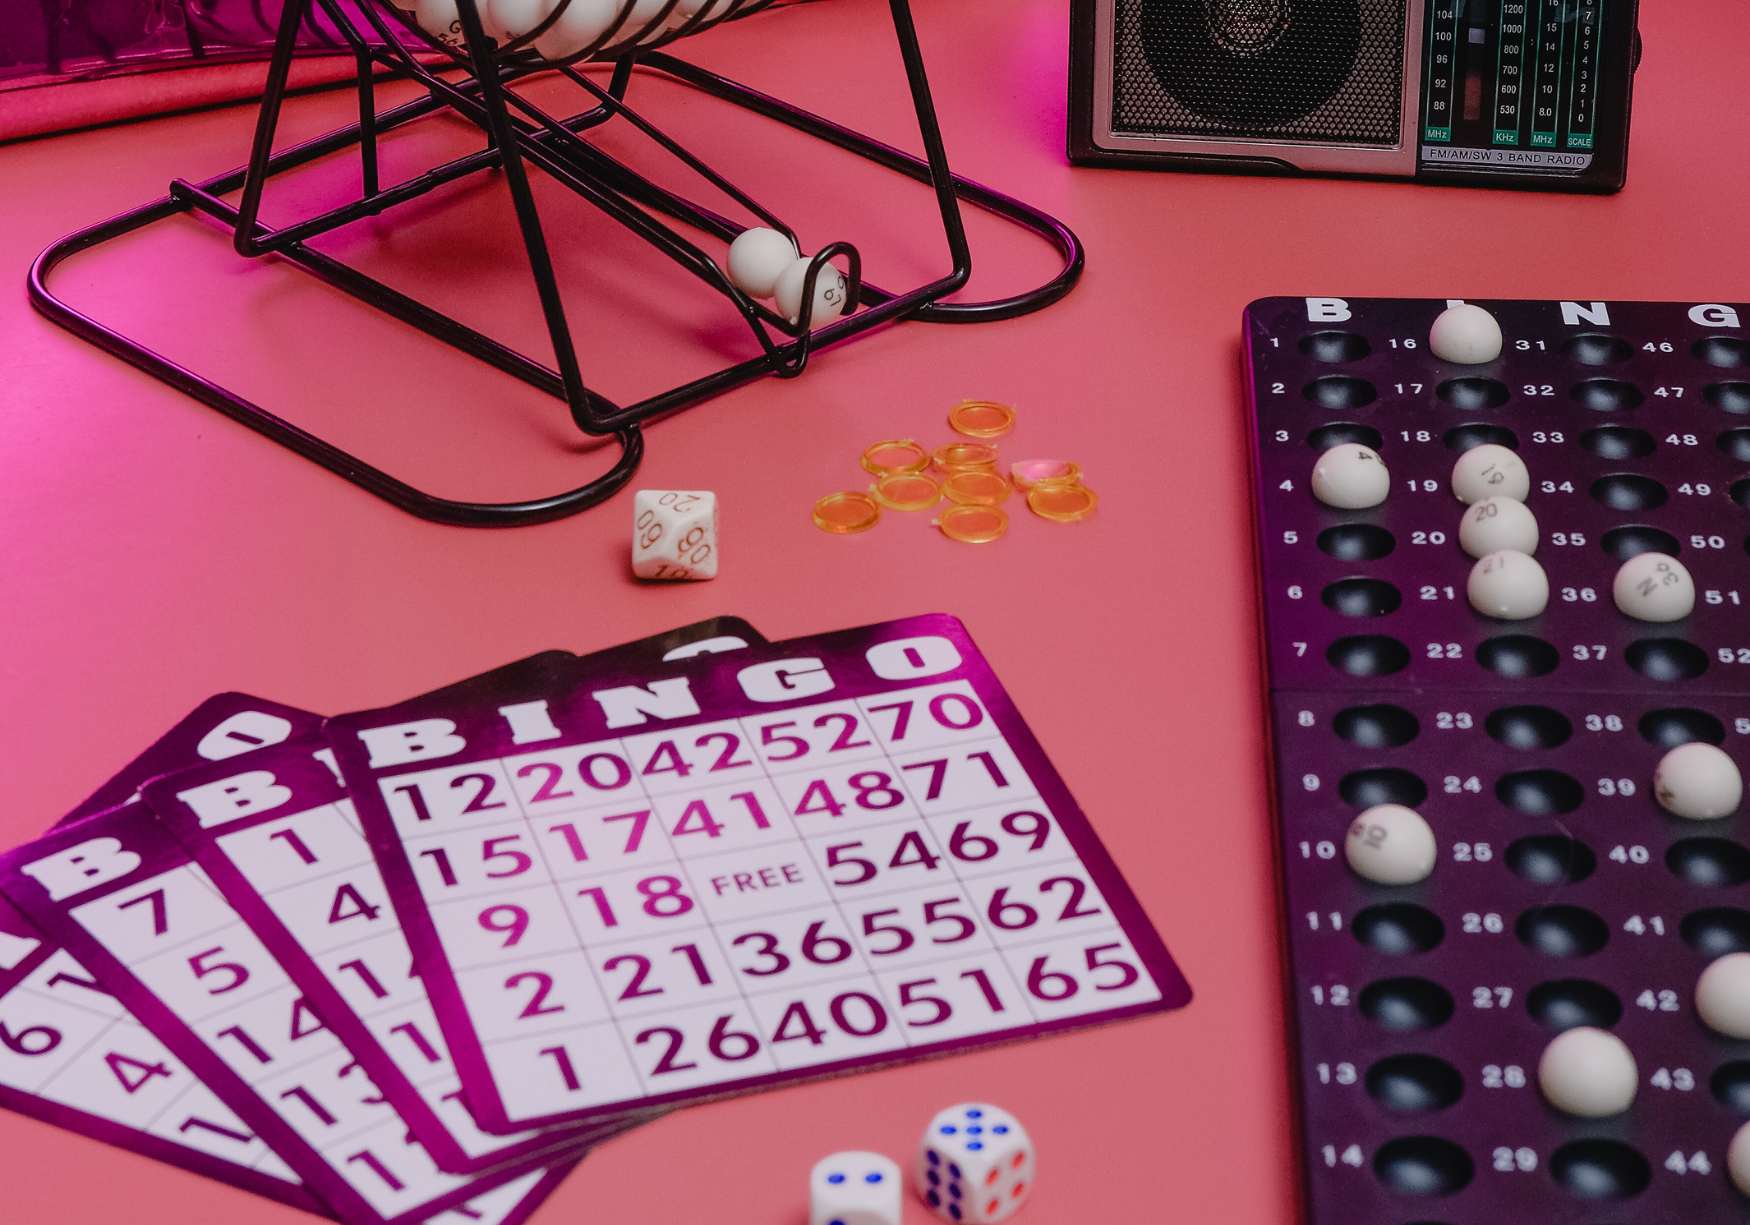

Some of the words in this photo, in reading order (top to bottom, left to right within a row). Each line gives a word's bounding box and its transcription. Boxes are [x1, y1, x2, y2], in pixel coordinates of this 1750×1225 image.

[1437, 10, 1453, 20] 104
[1504, 5, 1523, 14] 1200
[1586, 11, 1592, 20] 7
[1503, 24, 1522, 33] 1000
[1547, 23, 1557, 32] 15
[1584, 26, 1590, 35] 6
[1435, 32, 1452, 41] 100
[1504, 45, 1519, 54] 800
[1545, 42, 1555, 51] 14
[1584, 40, 1589, 49] 5
[1436, 54, 1448, 63] 96
[1582, 56, 1588, 64] 4
[1502, 66, 1518, 75] 700
[1544, 64, 1554, 73] 12
[1581, 71, 1587, 79] 3
[1435, 79, 1447, 88] 92
[1501, 85, 1516, 94] 600
[1543, 85, 1553, 93] 10
[1580, 83, 1586, 93] 2
[1433, 101, 1445, 110] 88
[1500, 105, 1515, 114] 530
[1539, 108, 1552, 116] 8.0
[1427, 129, 1447, 139] MHz
[1496, 133, 1514, 142] KHz
[1533, 135, 1553, 144] MHz
[1568, 138, 1592, 146] SCALE
[1430, 149, 1491, 161] FM/AM/SW
[1497, 152, 1503, 160] 3
[1509, 153, 1541, 163] BAND
[1547, 155, 1585, 165] RADIO
[1306, 298, 1352, 322] B
[1560, 302, 1611, 325] N
[1688, 304, 1740, 328] G
[1271, 338, 1280, 347] 1
[1390, 339, 1416, 348] 16
[1516, 340, 1545, 350] 31
[1643, 343, 1673, 352] 46
[1272, 383, 1284, 393] 2
[1395, 384, 1422, 393] 17
[1524, 385, 1554, 395] 32
[1654, 387, 1683, 397] 47
[1276, 431, 1288, 441] 3
[1401, 431, 1430, 441] 18
[1533, 432, 1564, 443] 33
[1666, 434, 1698, 445] 48
[1280, 480, 1293, 491] 4
[1408, 480, 1437, 491] 19
[1542, 481, 1574, 493] 34
[1678, 484, 1710, 495] 49
[1475, 503, 1498, 522] 20
[1284, 531, 1297, 544] 5
[1412, 532, 1445, 544] 20
[1552, 533, 1585, 545] 35
[1691, 536, 1724, 548] 50
[1288, 586, 1302, 599] 6
[1421, 586, 1454, 600] 21
[1562, 588, 1596, 601] 36
[1706, 591, 1739, 604] 51
[1293, 642, 1307, 656] 7
[1427, 643, 1462, 658] 22
[1573, 645, 1606, 660] 37
[1718, 648, 1750, 663] 52
[1299, 711, 1314, 726] 8
[1437, 712, 1473, 728] 23
[1586, 715, 1622, 731] 38
[393, 771, 504, 820] 12
[517, 752, 632, 803] 20
[642, 730, 752, 778] 42
[760, 712, 872, 761] 52
[867, 692, 985, 743] 70
[1303, 774, 1320, 791] 9
[1444, 776, 1481, 793] 24
[1598, 779, 1635, 796] 39
[419, 835, 532, 888] 15
[548, 811, 651, 862] 17
[671, 792, 771, 840] 41
[795, 769, 905, 818] 48
[900, 752, 1009, 800] 71
[1301, 841, 1335, 859] 10
[1454, 843, 1492, 861] 25
[1609, 846, 1649, 863] 40
[478, 905, 529, 946] 9
[578, 875, 693, 929] 18
[712, 863, 803, 897] FREE
[826, 832, 940, 886] 54
[949, 810, 1052, 862] 69
[328, 883, 381, 924] 4
[118, 888, 168, 936] 7
[1308, 912, 1342, 930] 11
[1463, 913, 1503, 932] 26
[1624, 916, 1664, 935] 41
[504, 971, 565, 1019] 2
[604, 944, 713, 1000] 21
[733, 920, 852, 976] 36
[862, 898, 976, 956] 55
[988, 876, 1102, 931] 62
[187, 946, 250, 995] 5
[1312, 985, 1349, 1005] 12
[1473, 987, 1512, 1008] 27
[1637, 990, 1678, 1011] 42
[540, 1046, 582, 1091] 1
[635, 1015, 761, 1077] 26
[771, 992, 887, 1045] 40
[899, 969, 1005, 1026] 51
[1027, 941, 1141, 1001] 65
[105, 1053, 172, 1094] 4
[1318, 1063, 1356, 1084] 13
[1483, 1065, 1525, 1087] 28
[1651, 1068, 1694, 1090] 43
[1323, 1145, 1362, 1167] 14
[1493, 1147, 1537, 1171] 29
[1666, 1151, 1710, 1174] 44
